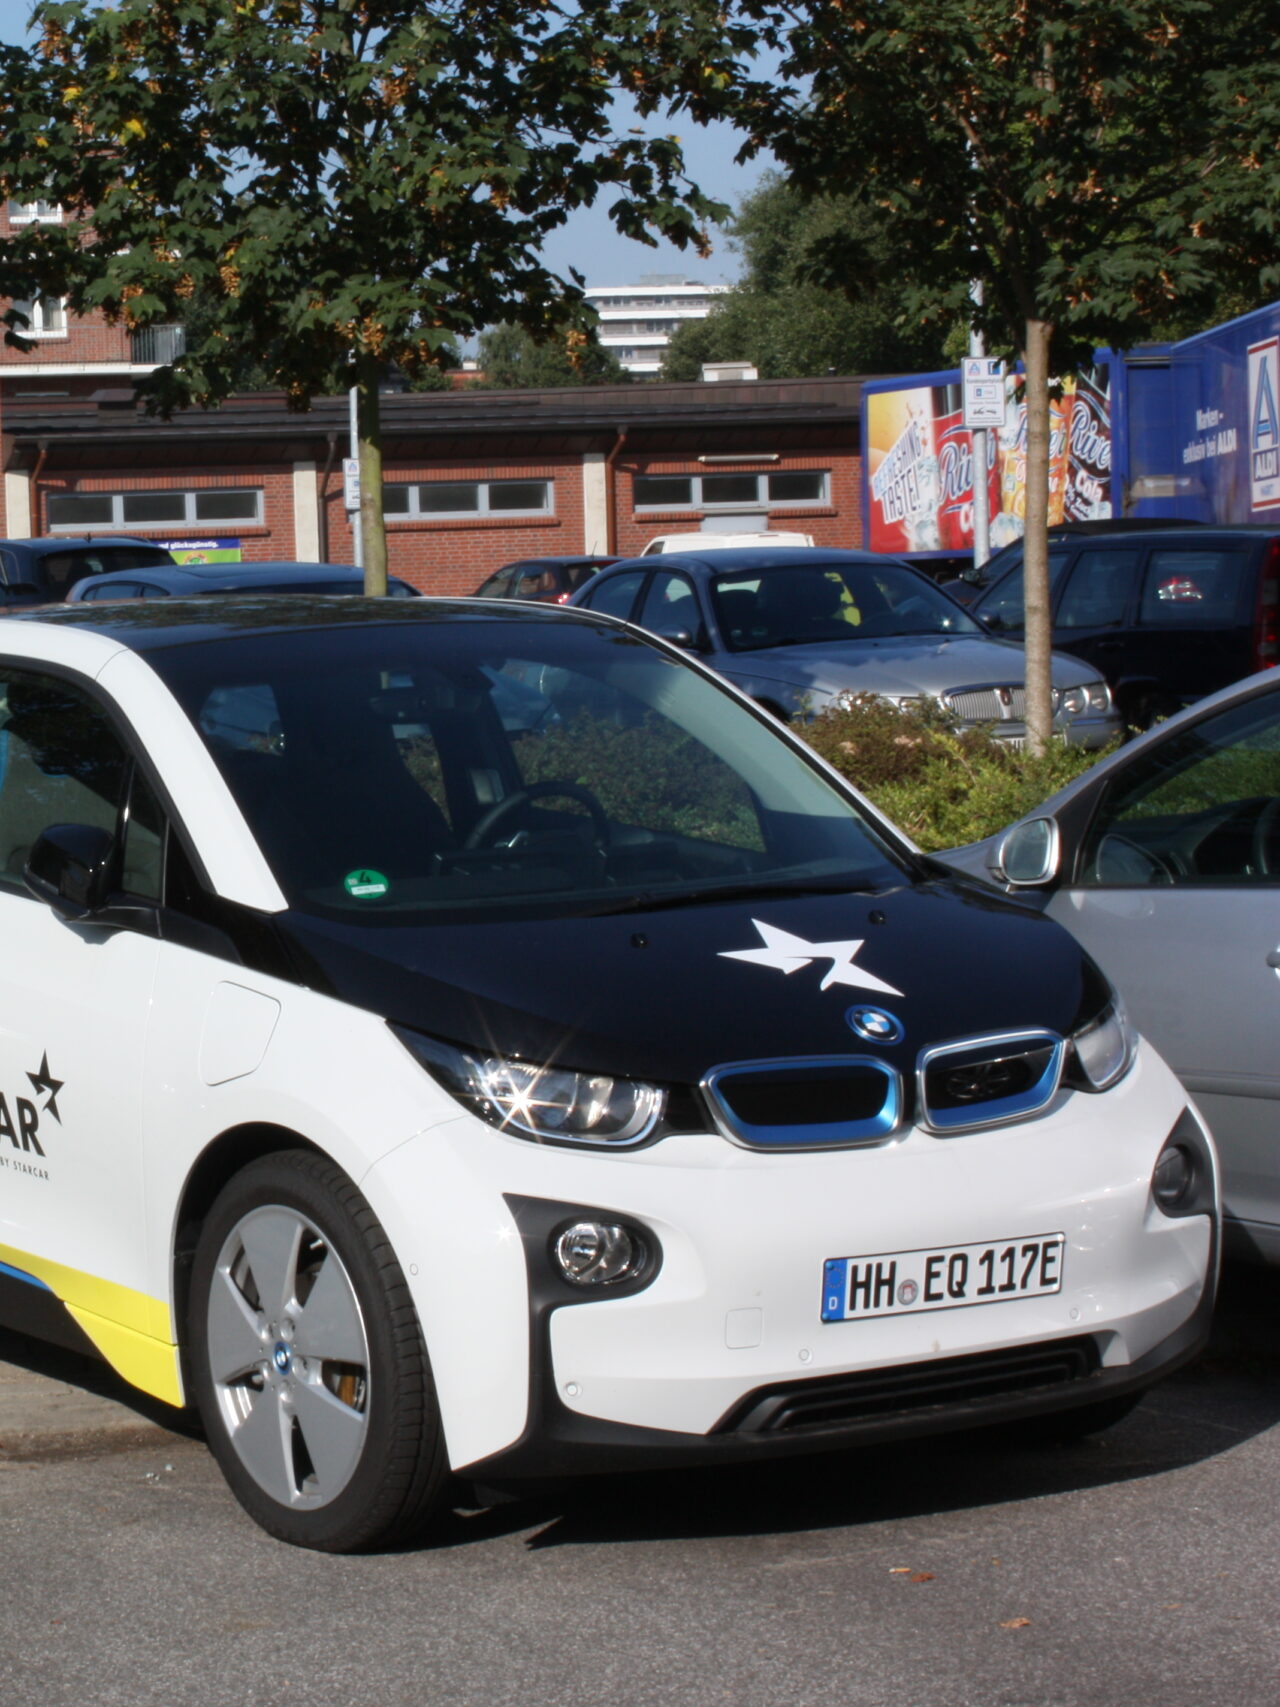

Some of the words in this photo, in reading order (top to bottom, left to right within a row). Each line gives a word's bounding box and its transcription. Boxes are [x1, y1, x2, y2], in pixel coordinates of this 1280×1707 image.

[1070, 401, 1112, 470] Rive
[1217, 428, 1237, 455] ALDI
[1255, 450, 1278, 479] ALDI
[882, 464, 921, 520] TASTE!
[1075, 470, 1103, 503] Cola
[360, 871, 372, 884] 4
[0, 1155, 9, 1168] BY
[13, 1160, 49, 1181] STARCAR
[849, 1260, 897, 1311] HH
[923, 1252, 968, 1302] EQ
[976, 1240, 1060, 1296] 117E
[828, 1297, 838, 1311] D
